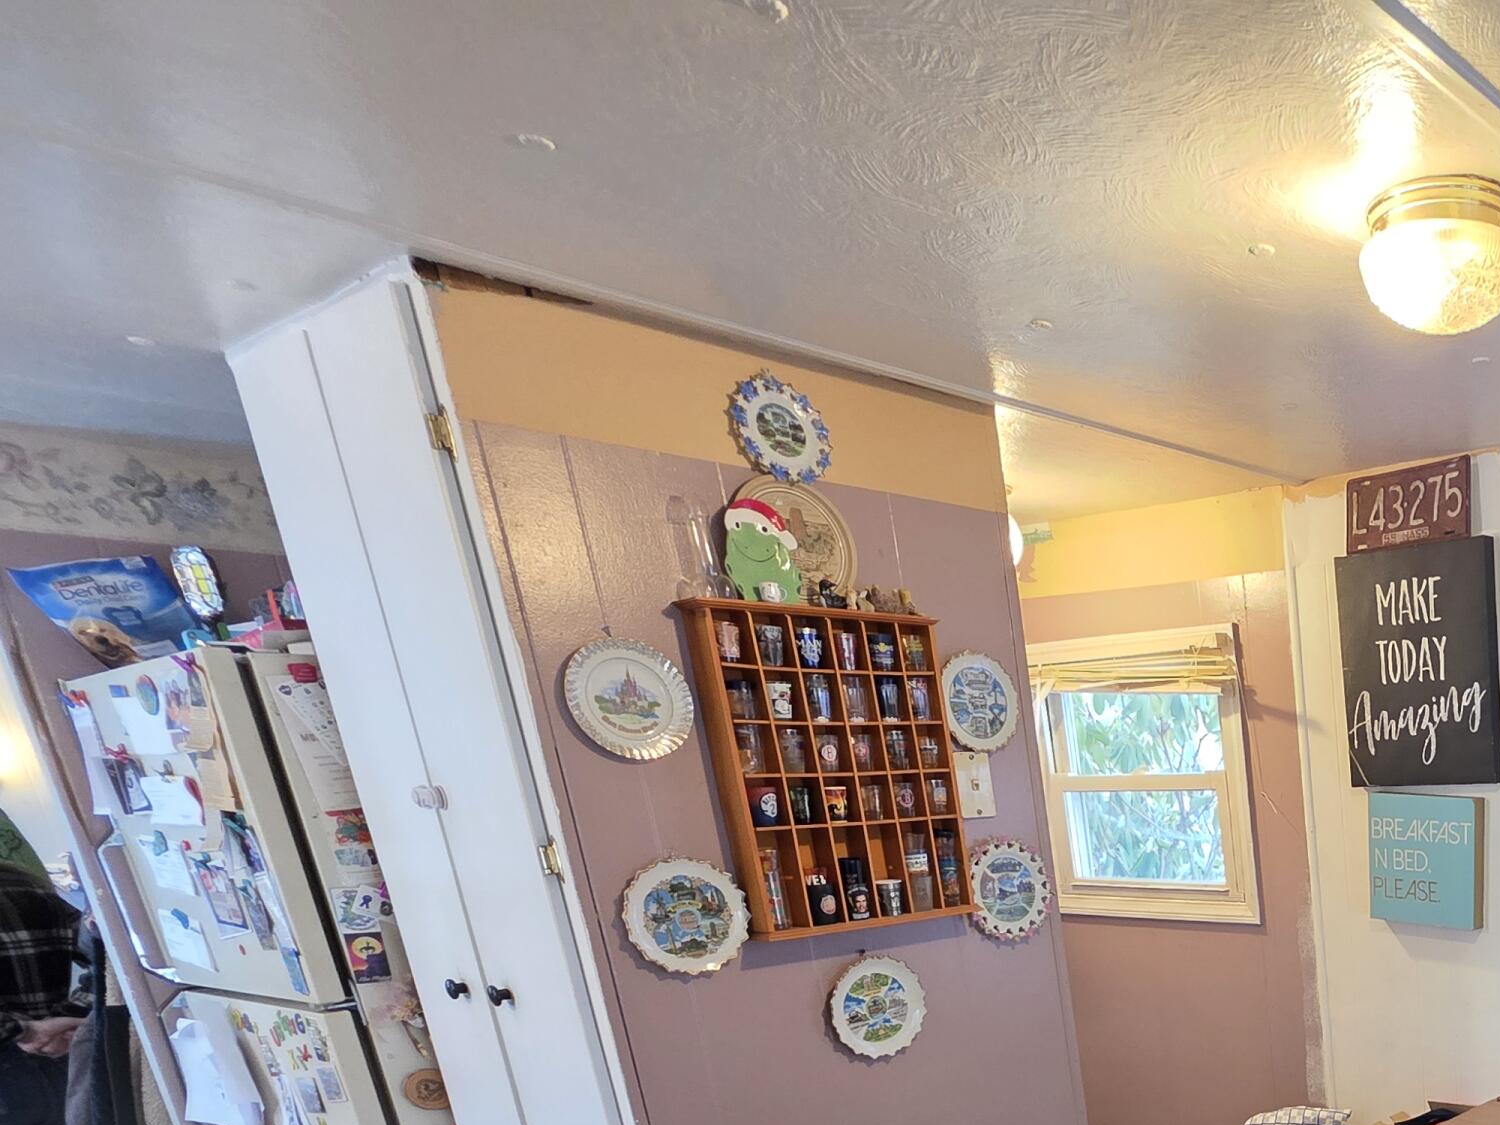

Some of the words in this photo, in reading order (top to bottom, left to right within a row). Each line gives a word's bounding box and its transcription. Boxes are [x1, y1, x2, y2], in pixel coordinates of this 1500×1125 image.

[1375, 575, 1442, 627] MAKE
[1375, 635, 1447, 686] TODAY
[1349, 681, 1487, 766] Amazing
[1371, 817, 1472, 845] BREAKFAST
